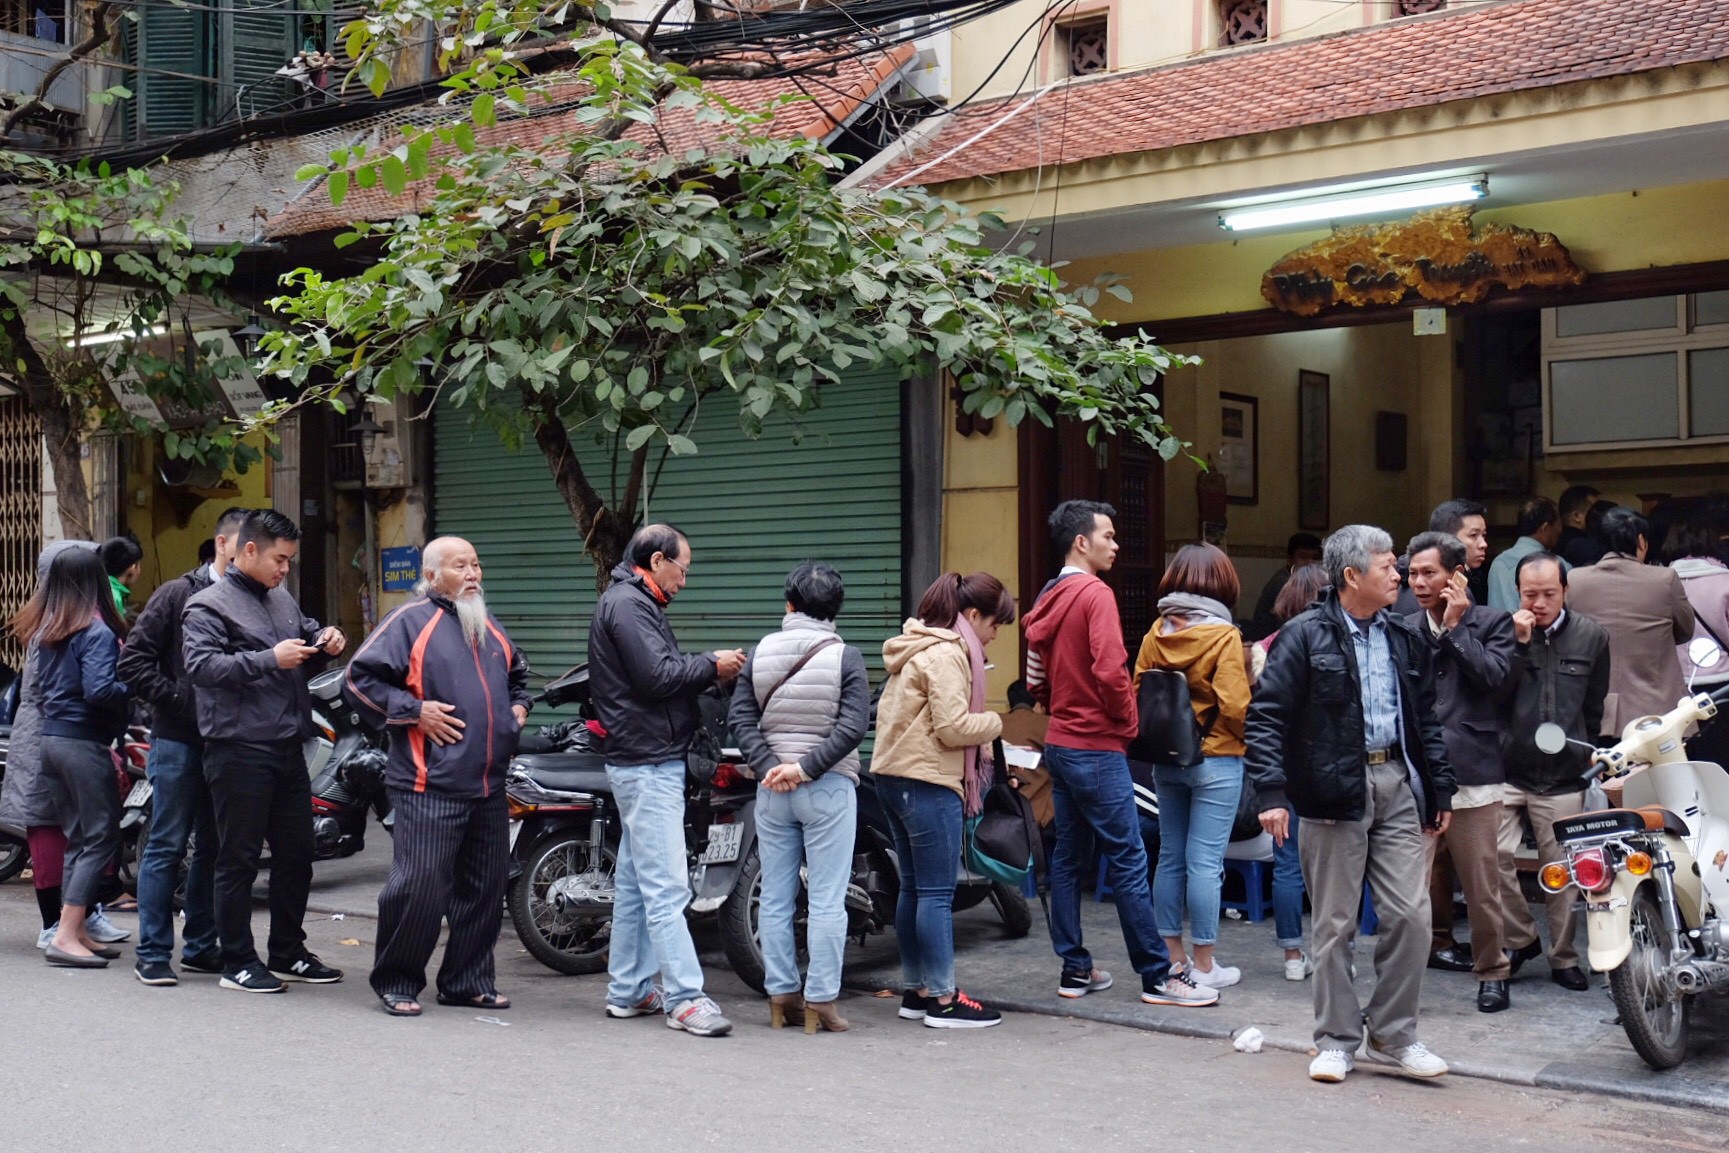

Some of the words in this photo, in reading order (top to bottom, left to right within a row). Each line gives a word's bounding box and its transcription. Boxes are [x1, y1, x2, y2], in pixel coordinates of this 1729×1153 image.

[385, 571, 400, 582] SIM
[1565, 824, 1585, 834] TAYA
[1586, 820, 1618, 831] MOTOR
[290, 960, 310, 974] N
[235, 969, 252, 984] N
